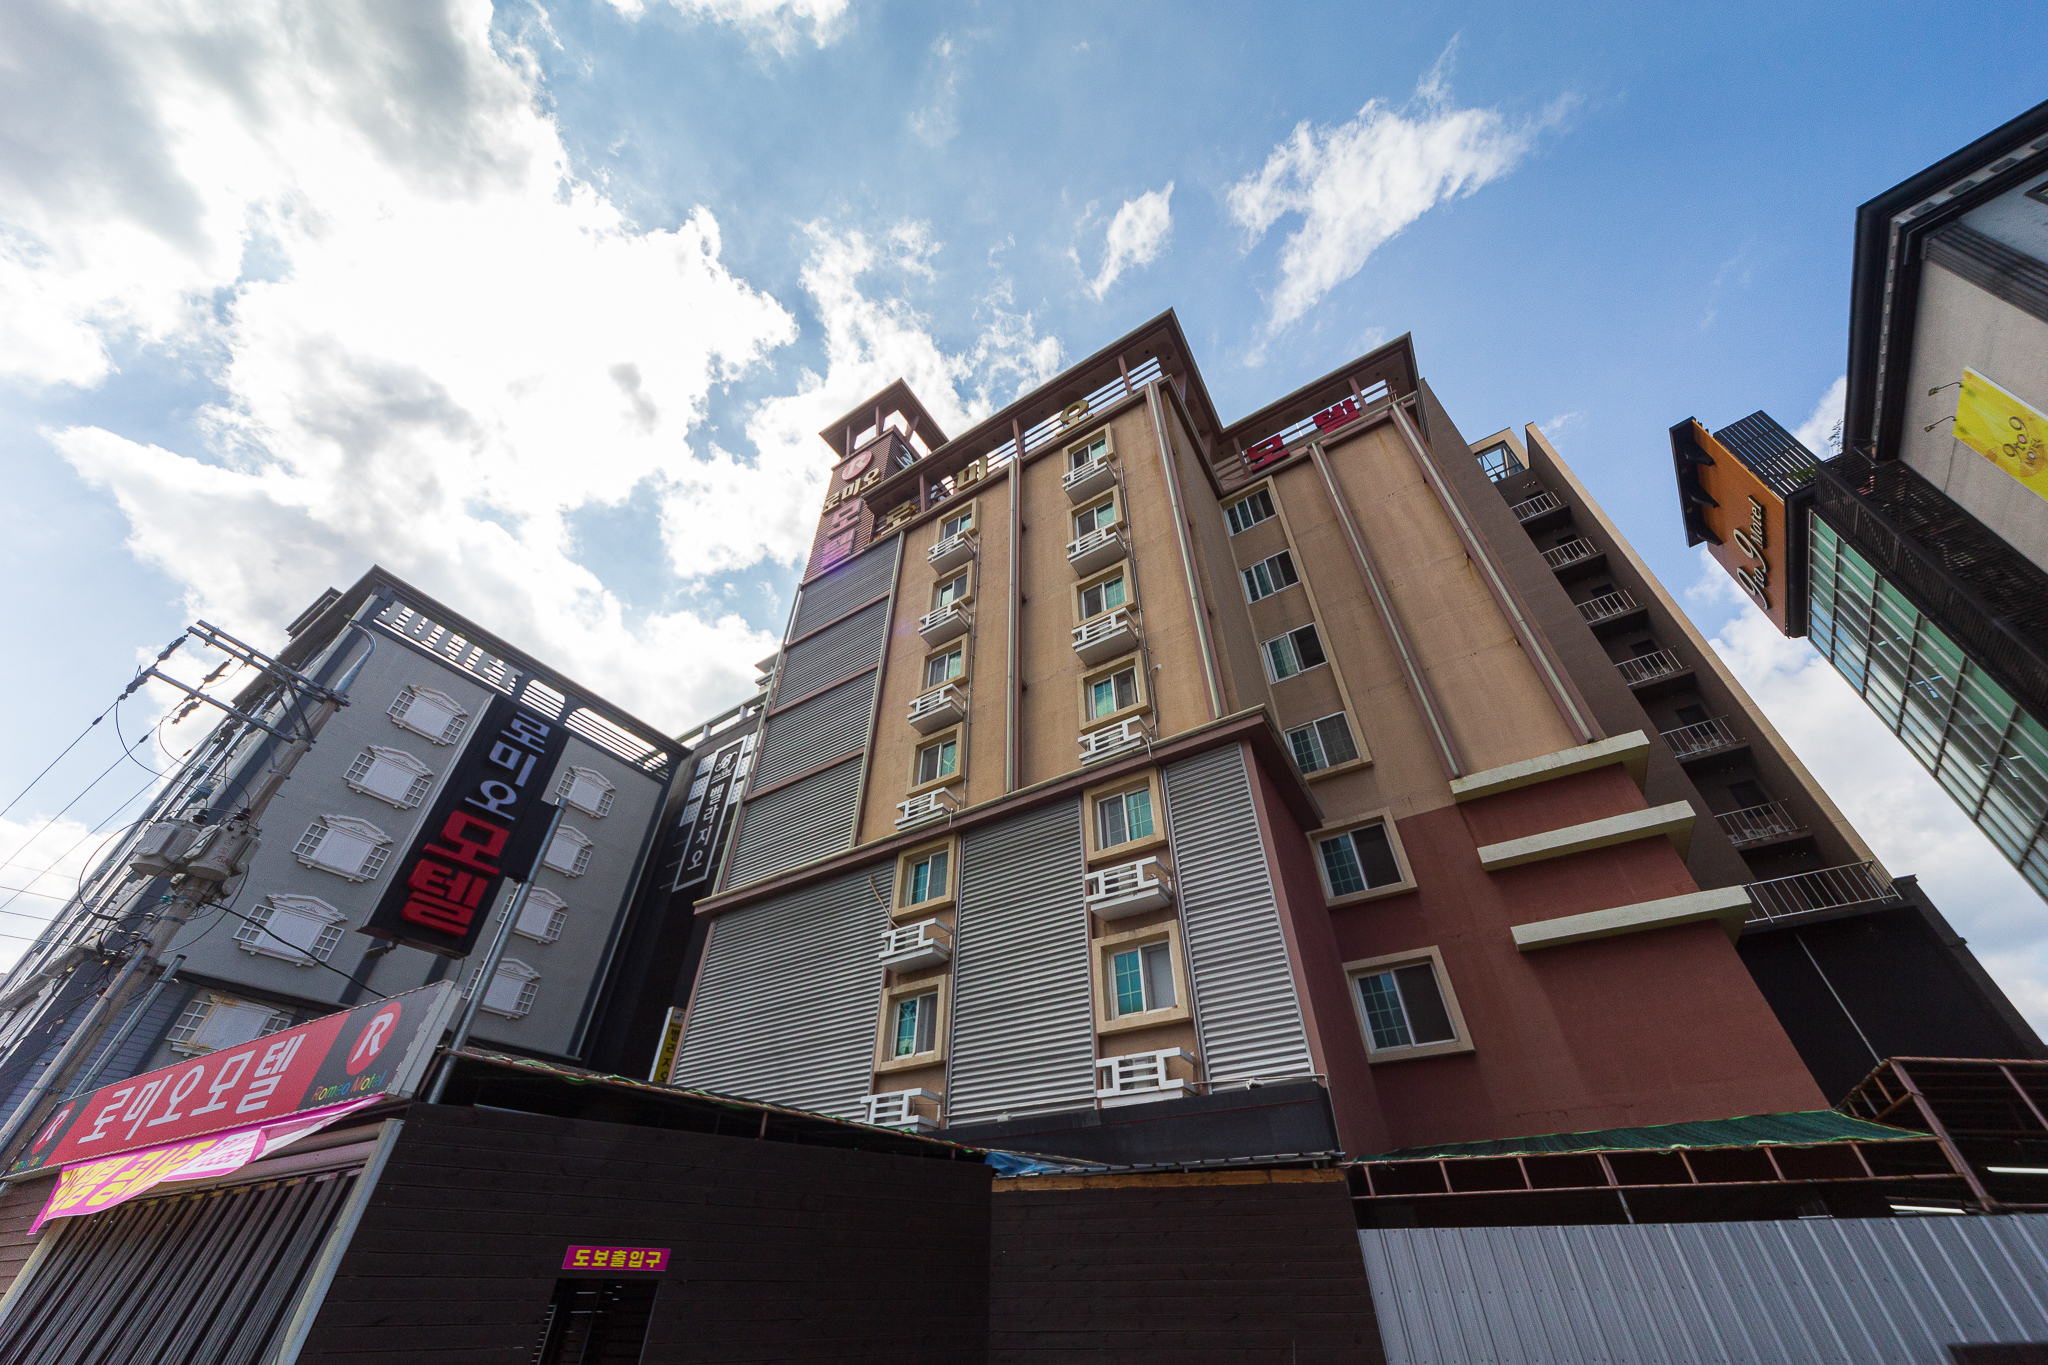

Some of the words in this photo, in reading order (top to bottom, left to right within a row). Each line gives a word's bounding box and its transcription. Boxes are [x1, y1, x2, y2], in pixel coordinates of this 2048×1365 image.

[1247, 398, 1362, 473] 모텔
[822, 467, 880, 516] 로미오
[1748, 496, 1764, 550] Motel
[821, 497, 862, 569] 모텔
[376, 600, 523, 692] JULIET
[465, 711, 550, 821] 로미오
[687, 782, 726, 871] 벨라지오
[401, 808, 512, 937] 모텔
[350, 1012, 394, 1064] R
[311, 1082, 351, 1102] Romeo
[350, 1070, 388, 1093] Motel
[572, 1249, 662, 1269] 도보출입구
